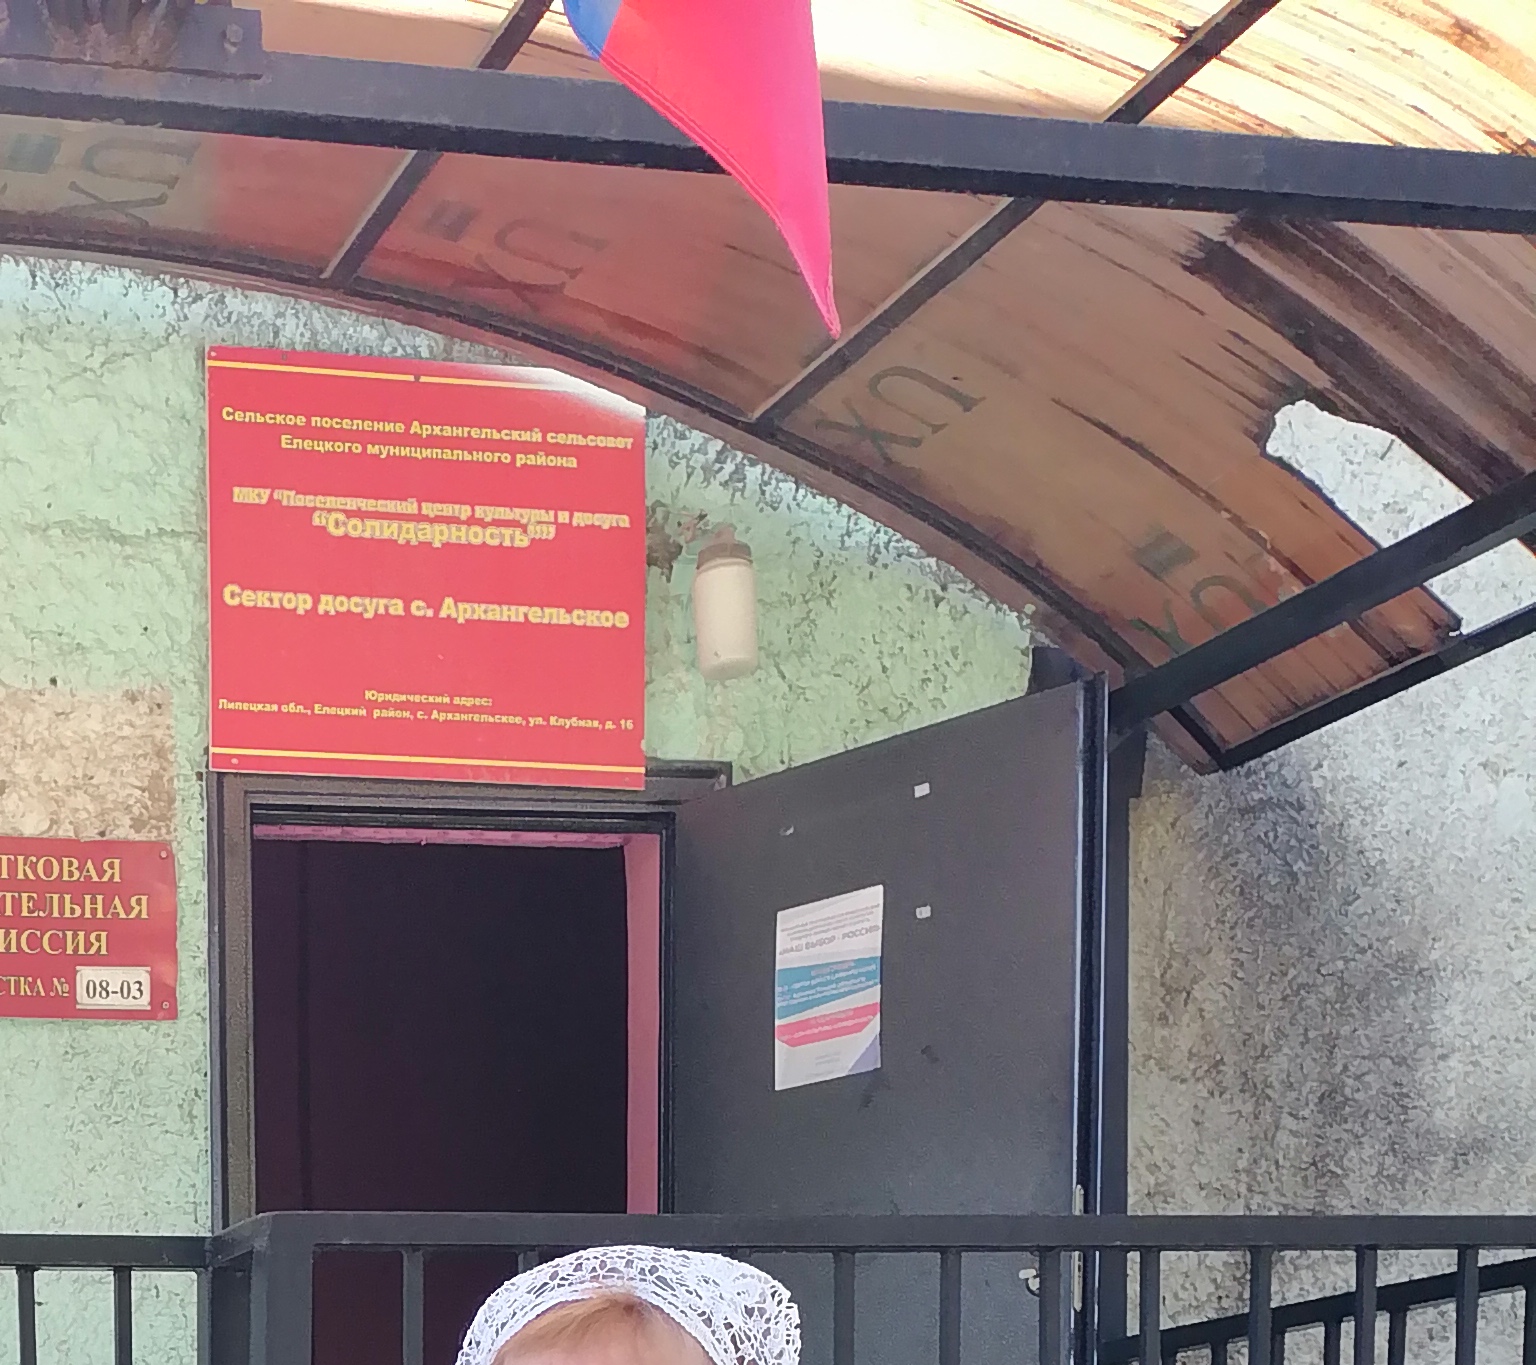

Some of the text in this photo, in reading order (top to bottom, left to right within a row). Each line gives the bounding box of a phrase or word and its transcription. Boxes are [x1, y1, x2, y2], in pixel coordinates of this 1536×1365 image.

[222, 406, 634, 450] Сельское поселение Архангельский сельсовет
[280, 434, 577, 468] Елецкого муниципального района
[233, 486, 271, 504] МКУ
[421, 501, 472, 520] центр
[474, 505, 555, 524] культуры
[572, 511, 631, 529] досуга
[222, 583, 630, 628] Сектор досуга с. Архангельское
[218, 699, 278, 713] Липецкая
[314, 703, 367, 717] Елецкий
[372, 708, 414, 721] район,
[364, 690, 493, 707] Юридический адрес:
[49, 978, 70, 998] №
[85, 979, 144, 1001] 08-03
